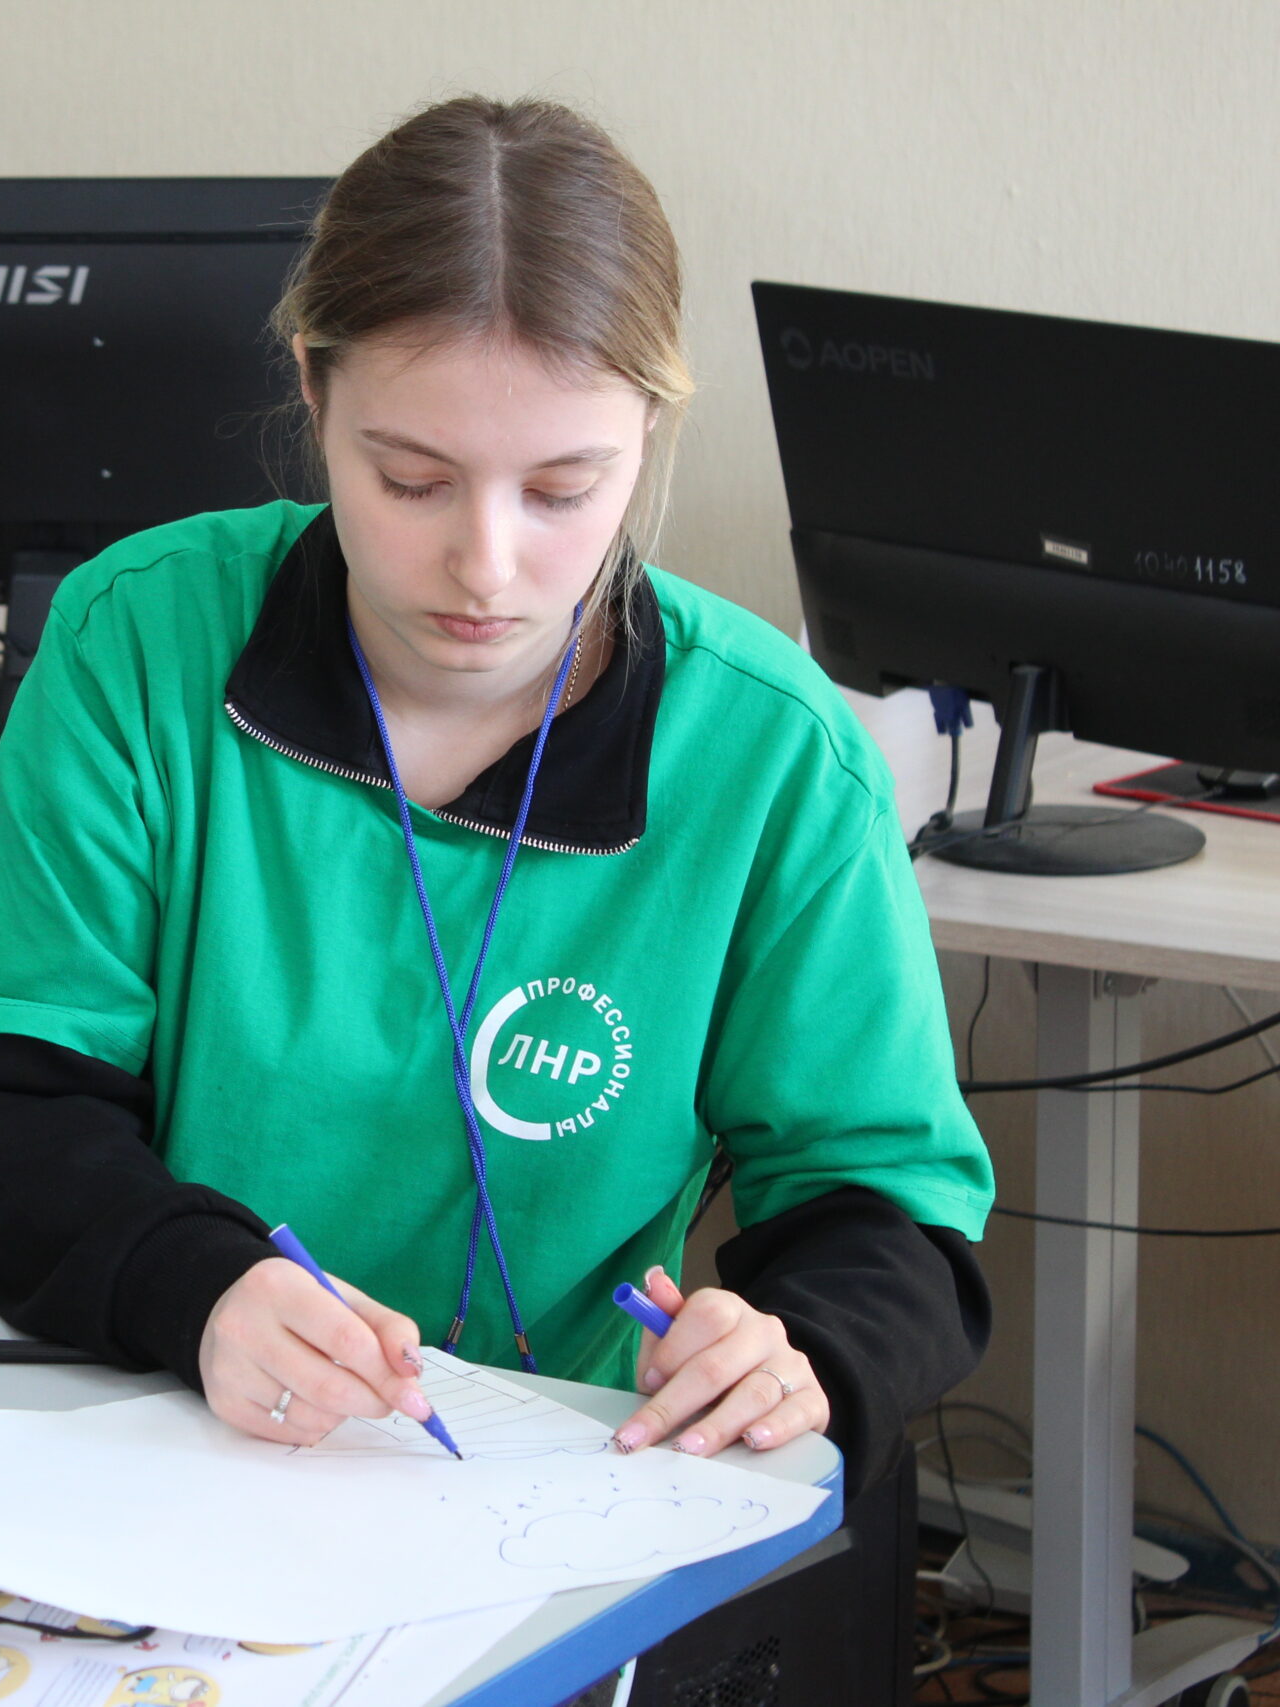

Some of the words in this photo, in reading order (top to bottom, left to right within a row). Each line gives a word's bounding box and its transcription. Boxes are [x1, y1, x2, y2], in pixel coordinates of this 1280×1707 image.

[820, 339, 935, 380] AOPEN
[497, 1034, 601, 1084] ЛНР
[527, 977, 632, 1137] ПРОФЕССИОНАЛЫ
